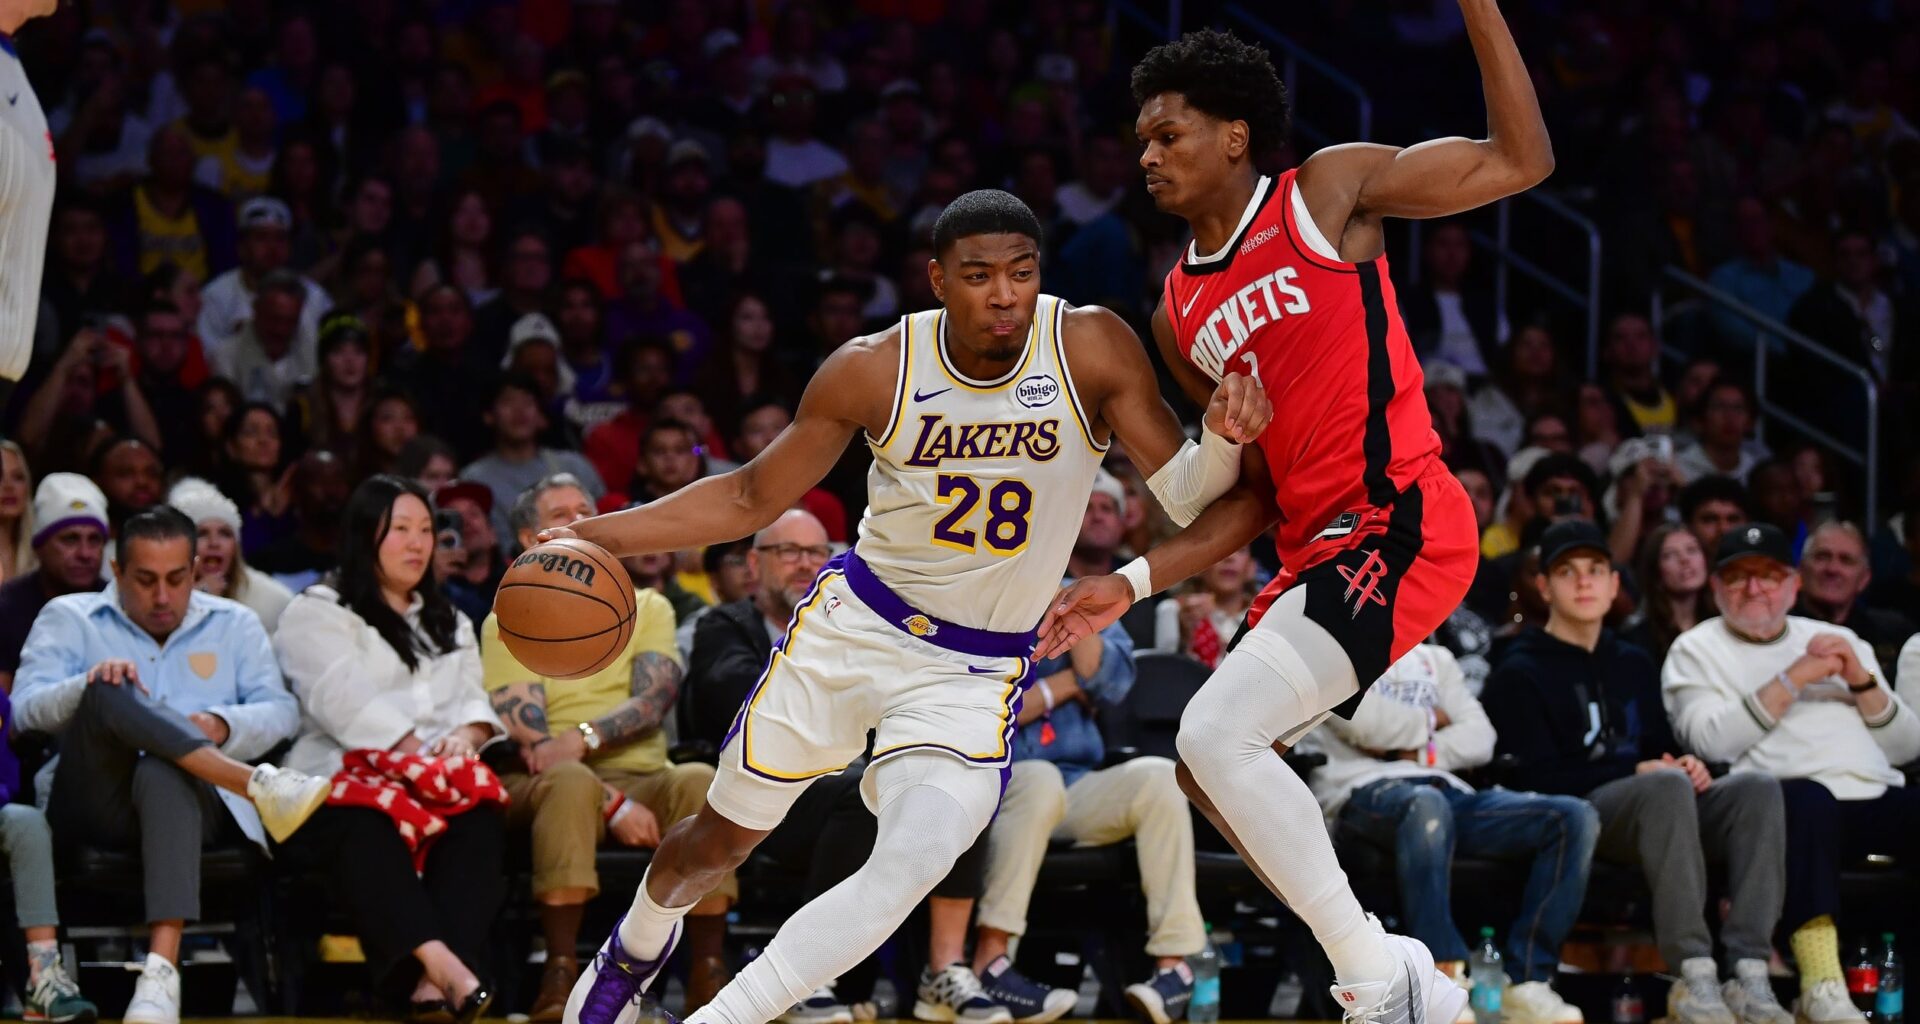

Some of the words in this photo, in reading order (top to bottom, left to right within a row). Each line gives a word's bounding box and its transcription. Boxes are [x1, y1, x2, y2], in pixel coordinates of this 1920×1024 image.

[1240, 224, 1279, 248] MEMORIAL
[1241, 229, 1280, 256] HERMANN
[1190, 265, 1310, 385] ROCKETS
[1019, 383, 1057, 397] bibigo
[904, 413, 1062, 469] LAKERS
[930, 472, 1035, 557] 28
[512, 553, 596, 588] Wilson
